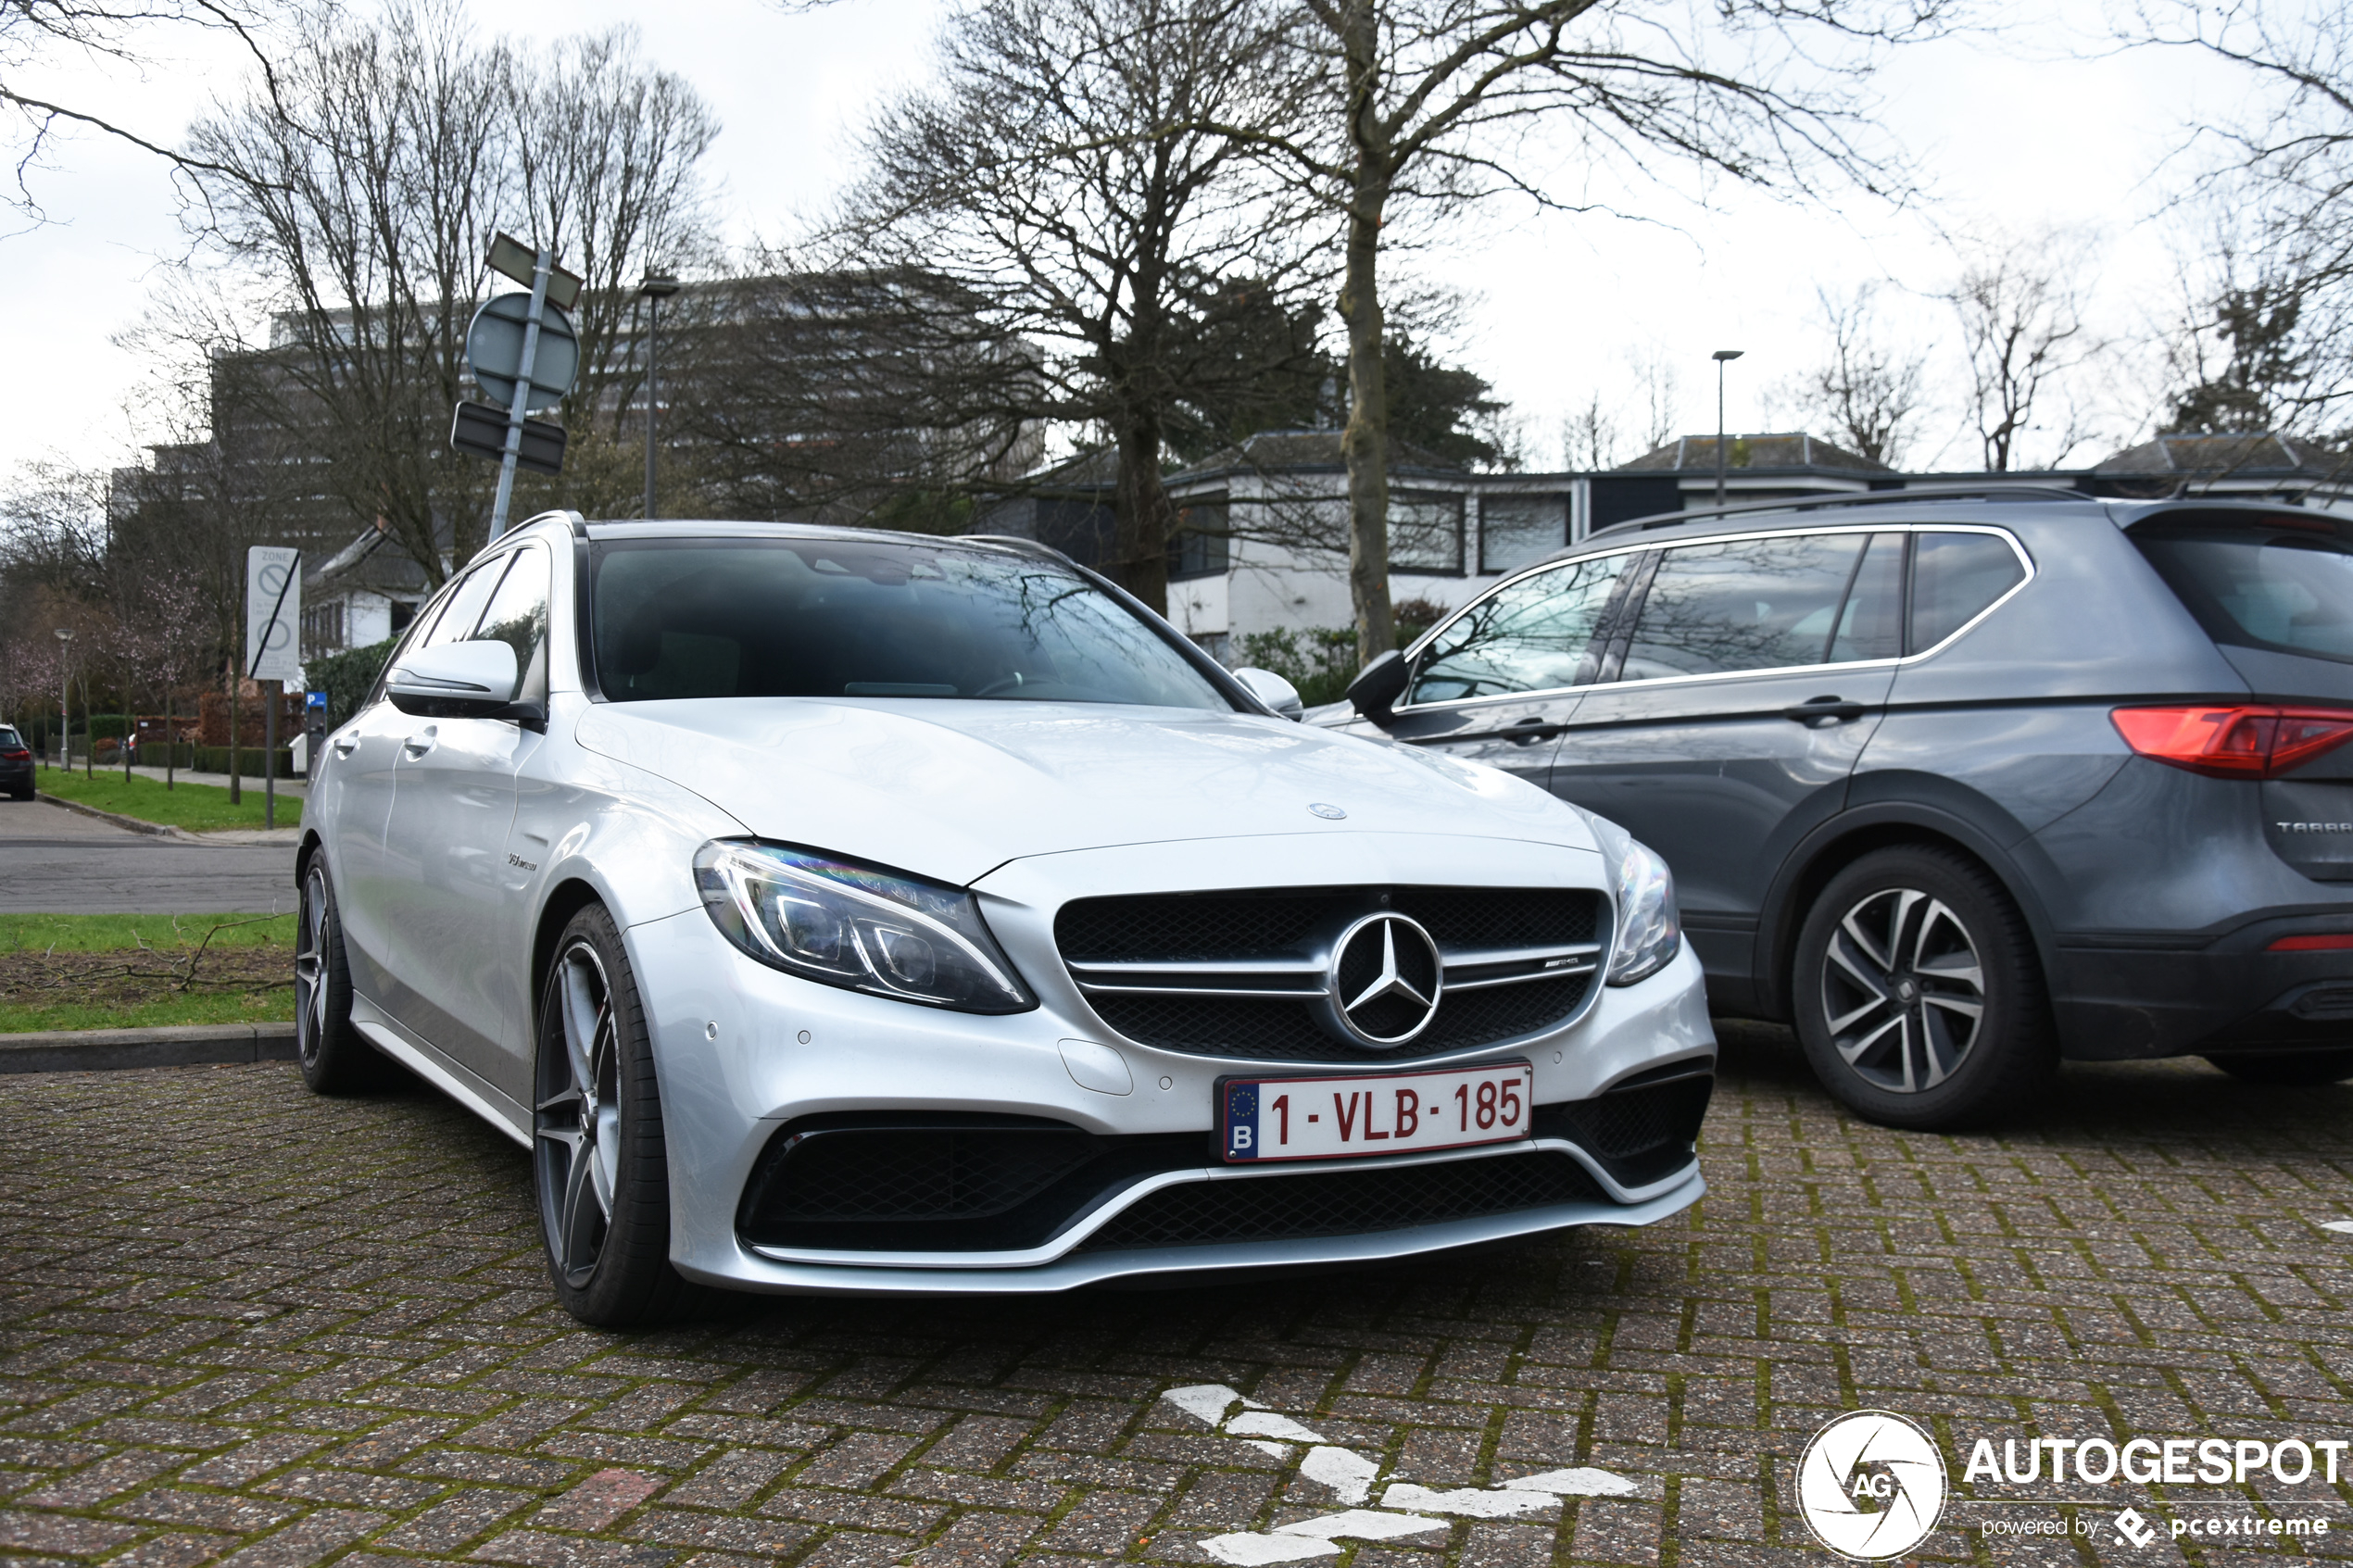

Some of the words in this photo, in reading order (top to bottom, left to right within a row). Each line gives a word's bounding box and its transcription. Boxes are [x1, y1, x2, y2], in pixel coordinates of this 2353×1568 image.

[262, 551, 289, 562] ZONE
[308, 694, 316, 705] P
[1233, 1125, 1252, 1149] B
